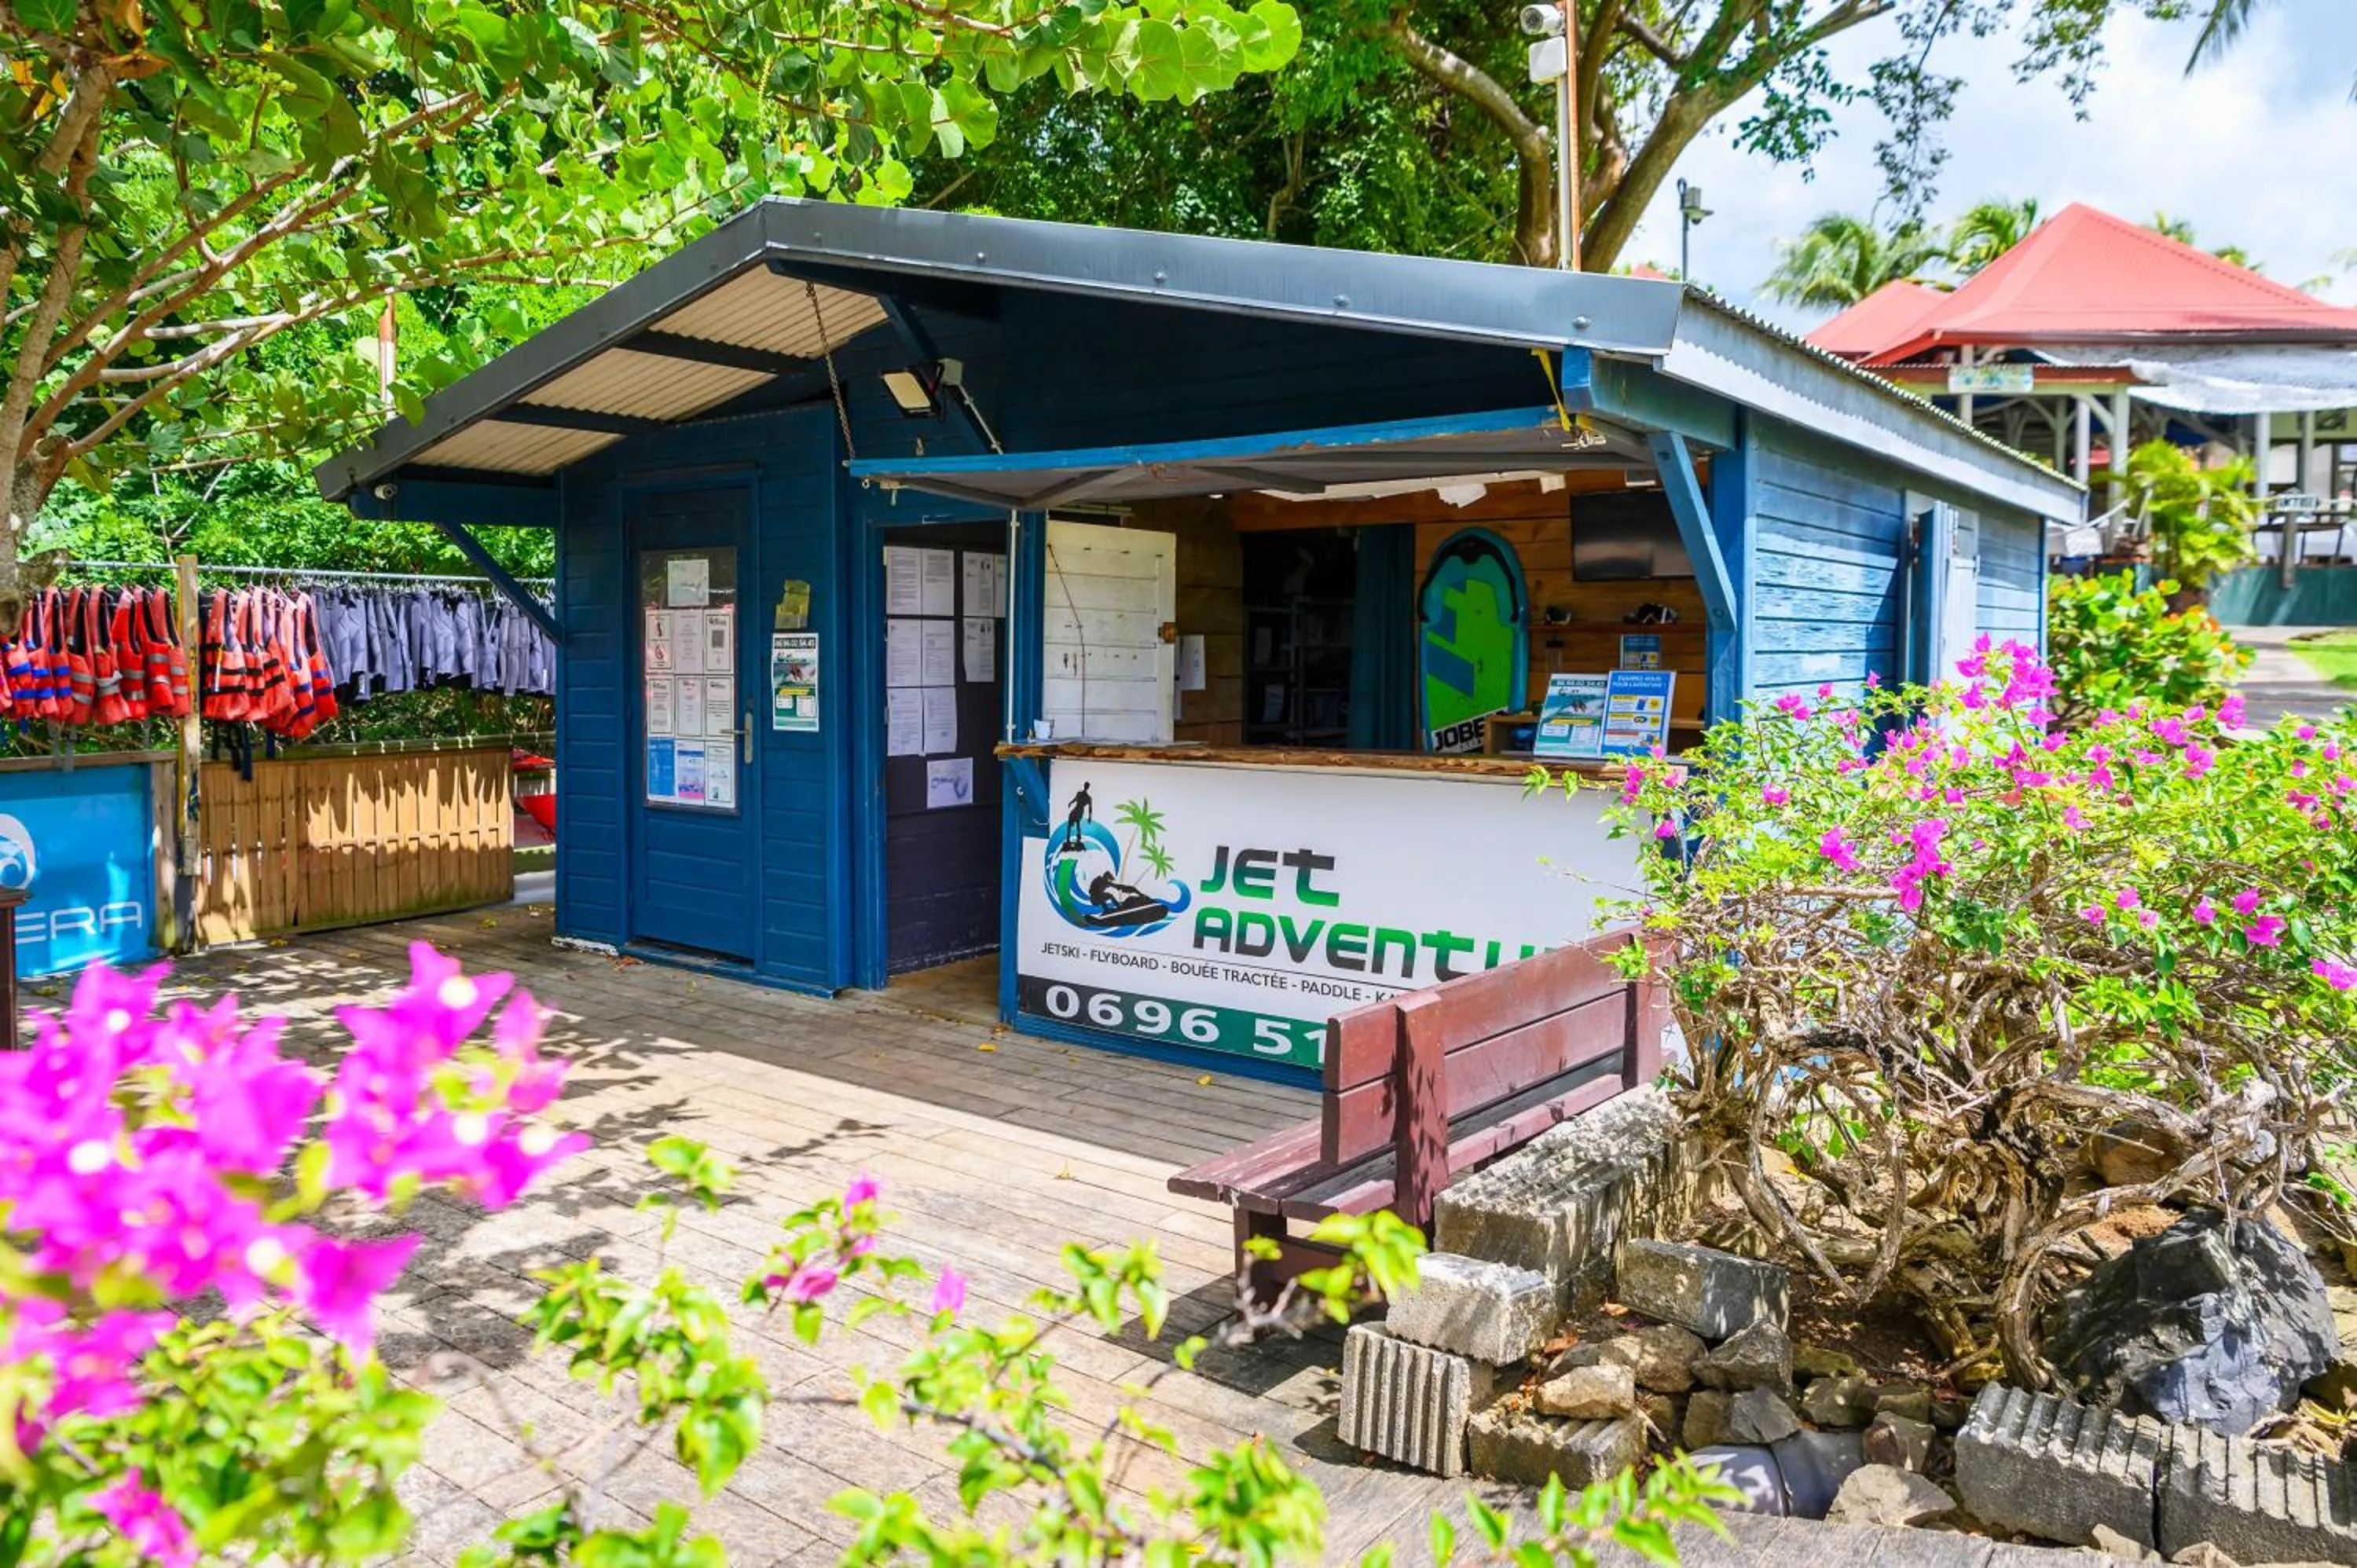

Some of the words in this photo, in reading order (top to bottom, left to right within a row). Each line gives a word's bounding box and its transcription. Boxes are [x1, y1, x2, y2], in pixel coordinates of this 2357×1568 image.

[1435, 715, 1484, 752] JOBE
[1041, 942, 1080, 960] JETSKI
[1090, 950, 1159, 970] FLYBOARD
[1171, 960, 1219, 980] BOUÉE
[1222, 968, 1288, 990] TRACTÉE
[1301, 980, 1361, 1002] PADDLE
[1046, 985, 1220, 1043] 0696
[1253, 1018, 1327, 1064] 51
